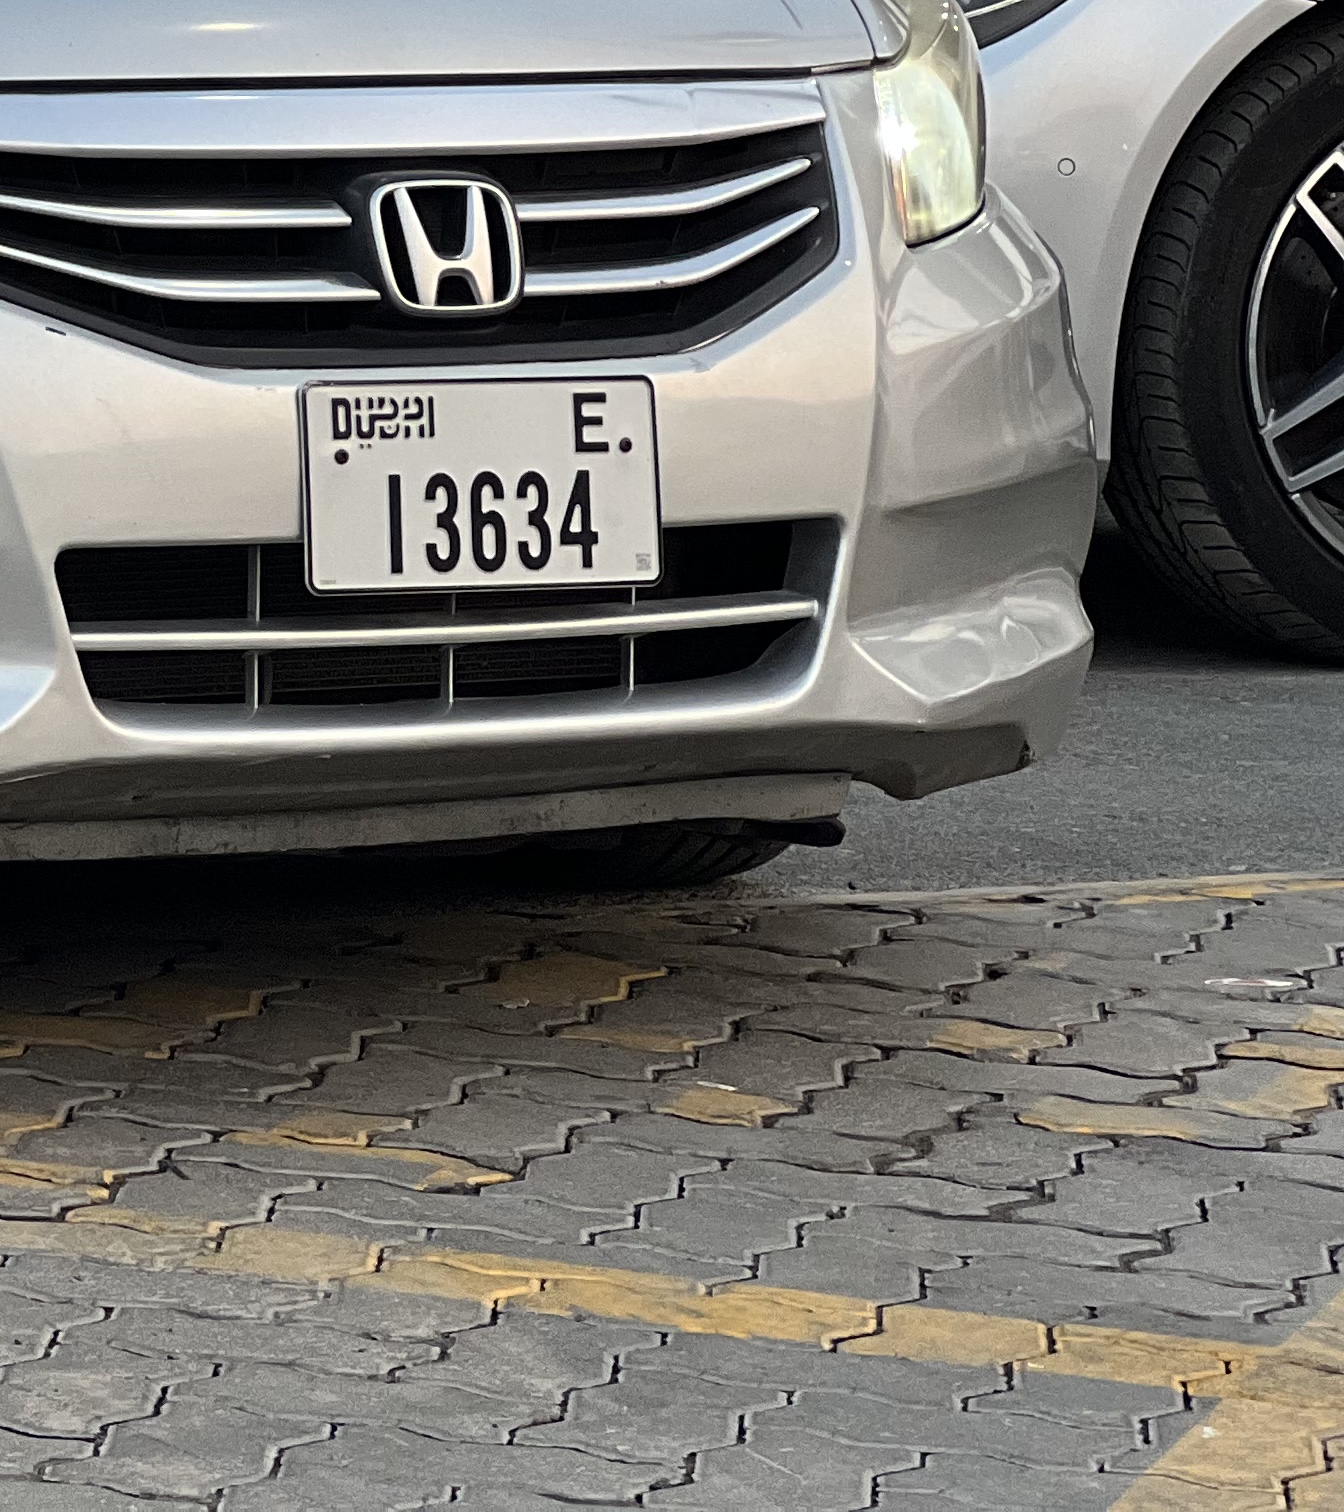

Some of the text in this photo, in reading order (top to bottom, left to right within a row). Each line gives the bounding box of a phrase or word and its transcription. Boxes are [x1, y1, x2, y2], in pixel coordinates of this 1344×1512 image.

[331, 391, 610, 453] DUBAI E
[388, 469, 599, 575] 13634
